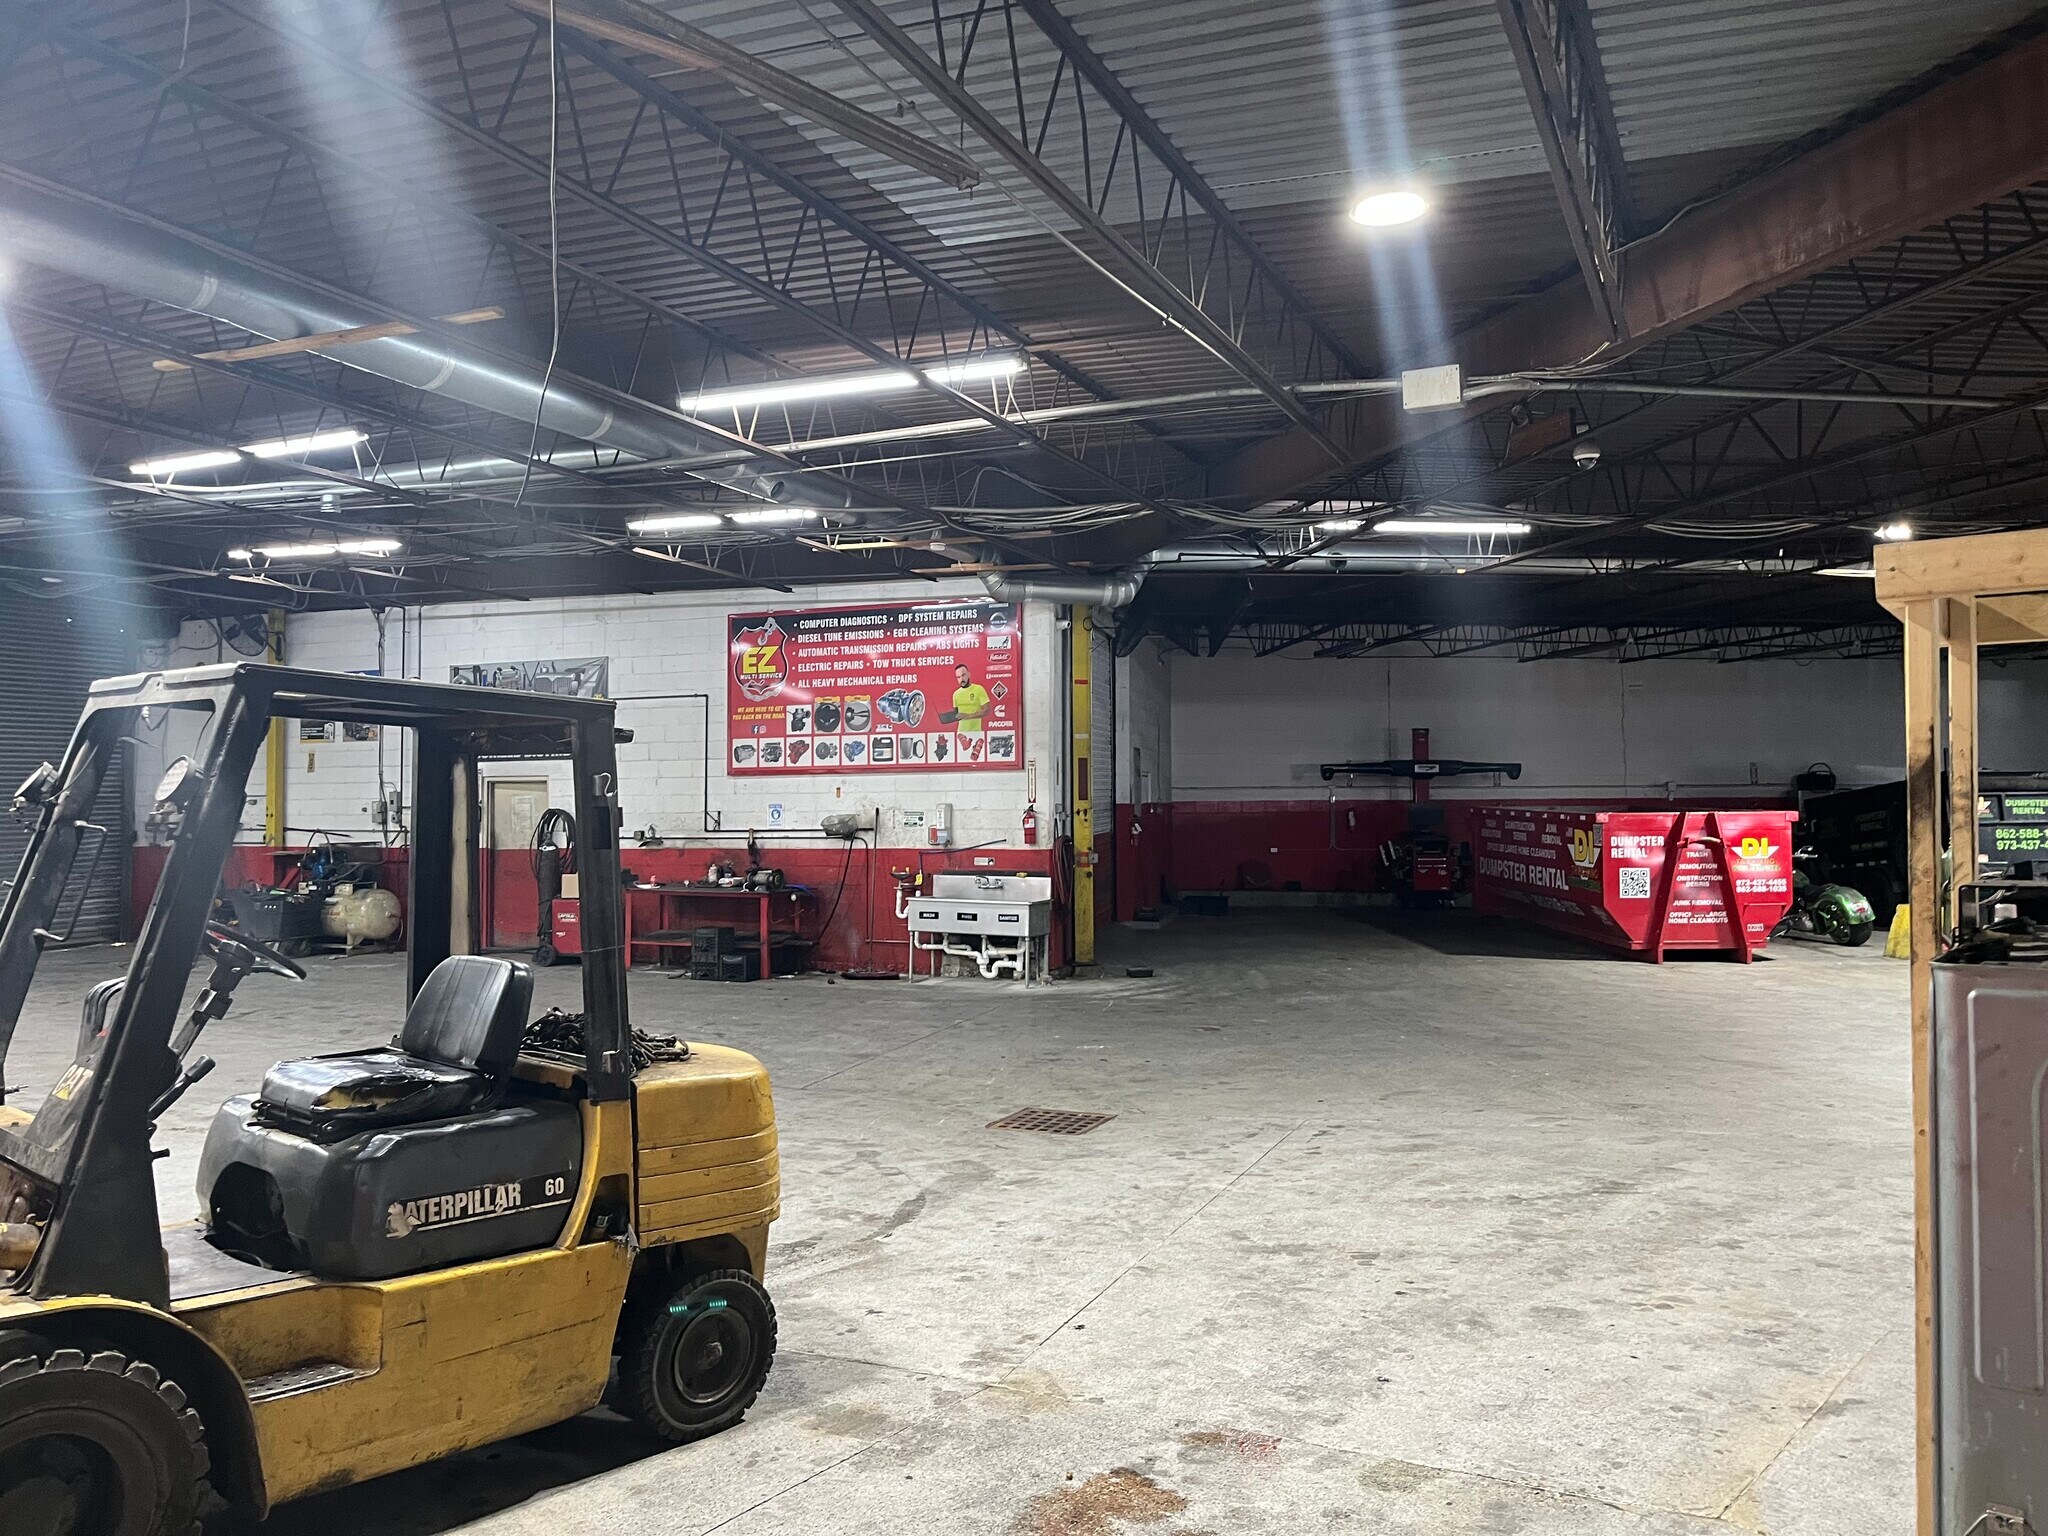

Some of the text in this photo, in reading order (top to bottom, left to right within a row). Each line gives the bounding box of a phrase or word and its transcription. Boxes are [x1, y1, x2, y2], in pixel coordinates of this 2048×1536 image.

[800, 615, 888, 629] COMPUTER DIAGNOSTICS
[898, 609, 978, 623] DPF SYSTEM REPAIRS
[798, 629, 884, 643] DIESEL TUNE EMISSIONS
[893, 623, 984, 638] EGR CLEANING SYSTEMS
[798, 642, 927, 658] AUTOMATIC TRANSMISSION REPAIRS
[936, 639, 980, 650] ABS LIGHTS
[742, 645, 780, 674] EZ
[798, 660, 864, 672] ELECTRIC REPAIRS
[873, 655, 954, 668] TOW TRUCK SERVICES
[758, 672, 783, 680] SERVICE
[798, 674, 918, 689] ALL HEAVY MECHANICAL REPAIRS
[2012, 807, 2046, 815] RENTAL
[1573, 828, 1595, 864] DI
[1610, 835, 1665, 847] DUMPSTER
[1741, 837, 1768, 857] DI
[1610, 847, 1648, 858] RENTAL
[1479, 856, 1527, 883] DUMPSTER
[1529, 864, 1570, 891] RENTAL
[1673, 899, 1691, 907] JUNK
[1689, 916, 1728, 924] CLEANOUTS
[52, 1064, 94, 1101] CAT
[545, 1177, 565, 1197] 60
